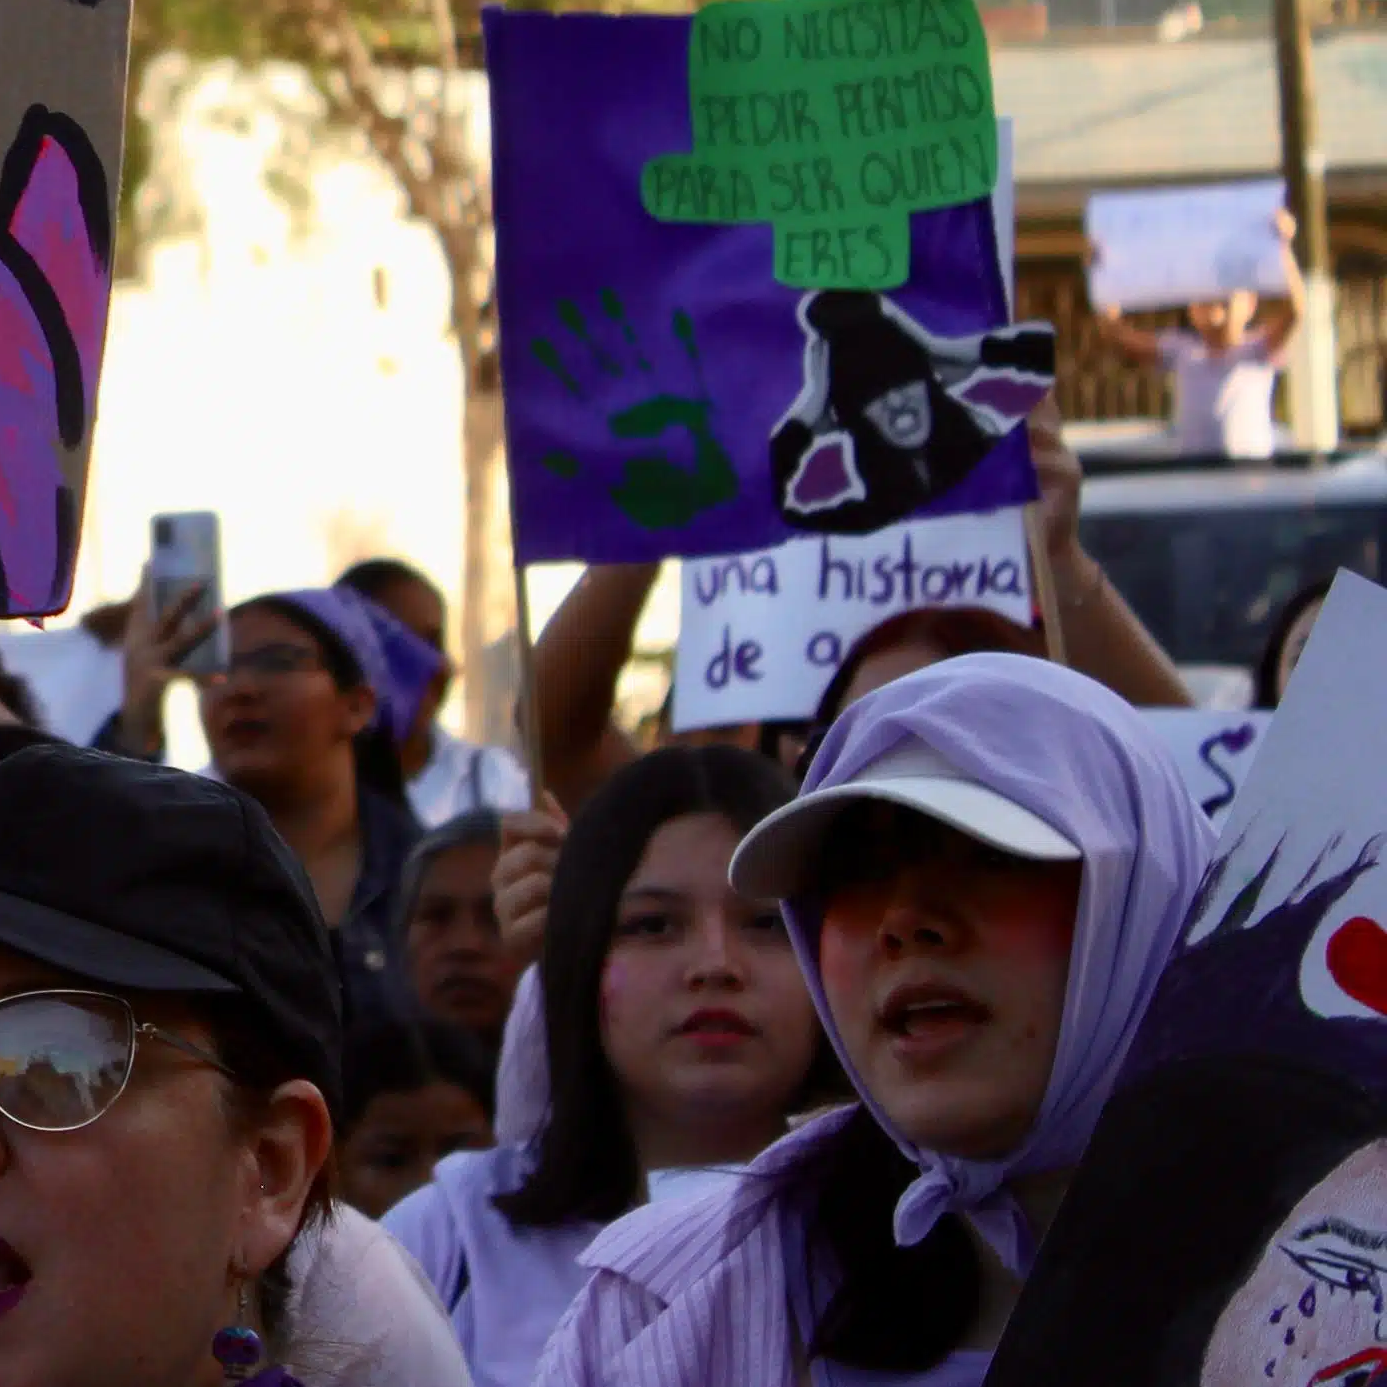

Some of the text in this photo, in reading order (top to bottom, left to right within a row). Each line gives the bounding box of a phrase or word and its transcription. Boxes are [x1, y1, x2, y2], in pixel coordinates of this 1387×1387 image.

[698, 16, 763, 66] NO
[698, 63, 986, 147] PEDIR PERMISO
[652, 162, 757, 219] PARA
[768, 156, 845, 214] SER
[694, 532, 1026, 607] una historia
[704, 622, 765, 690] de
